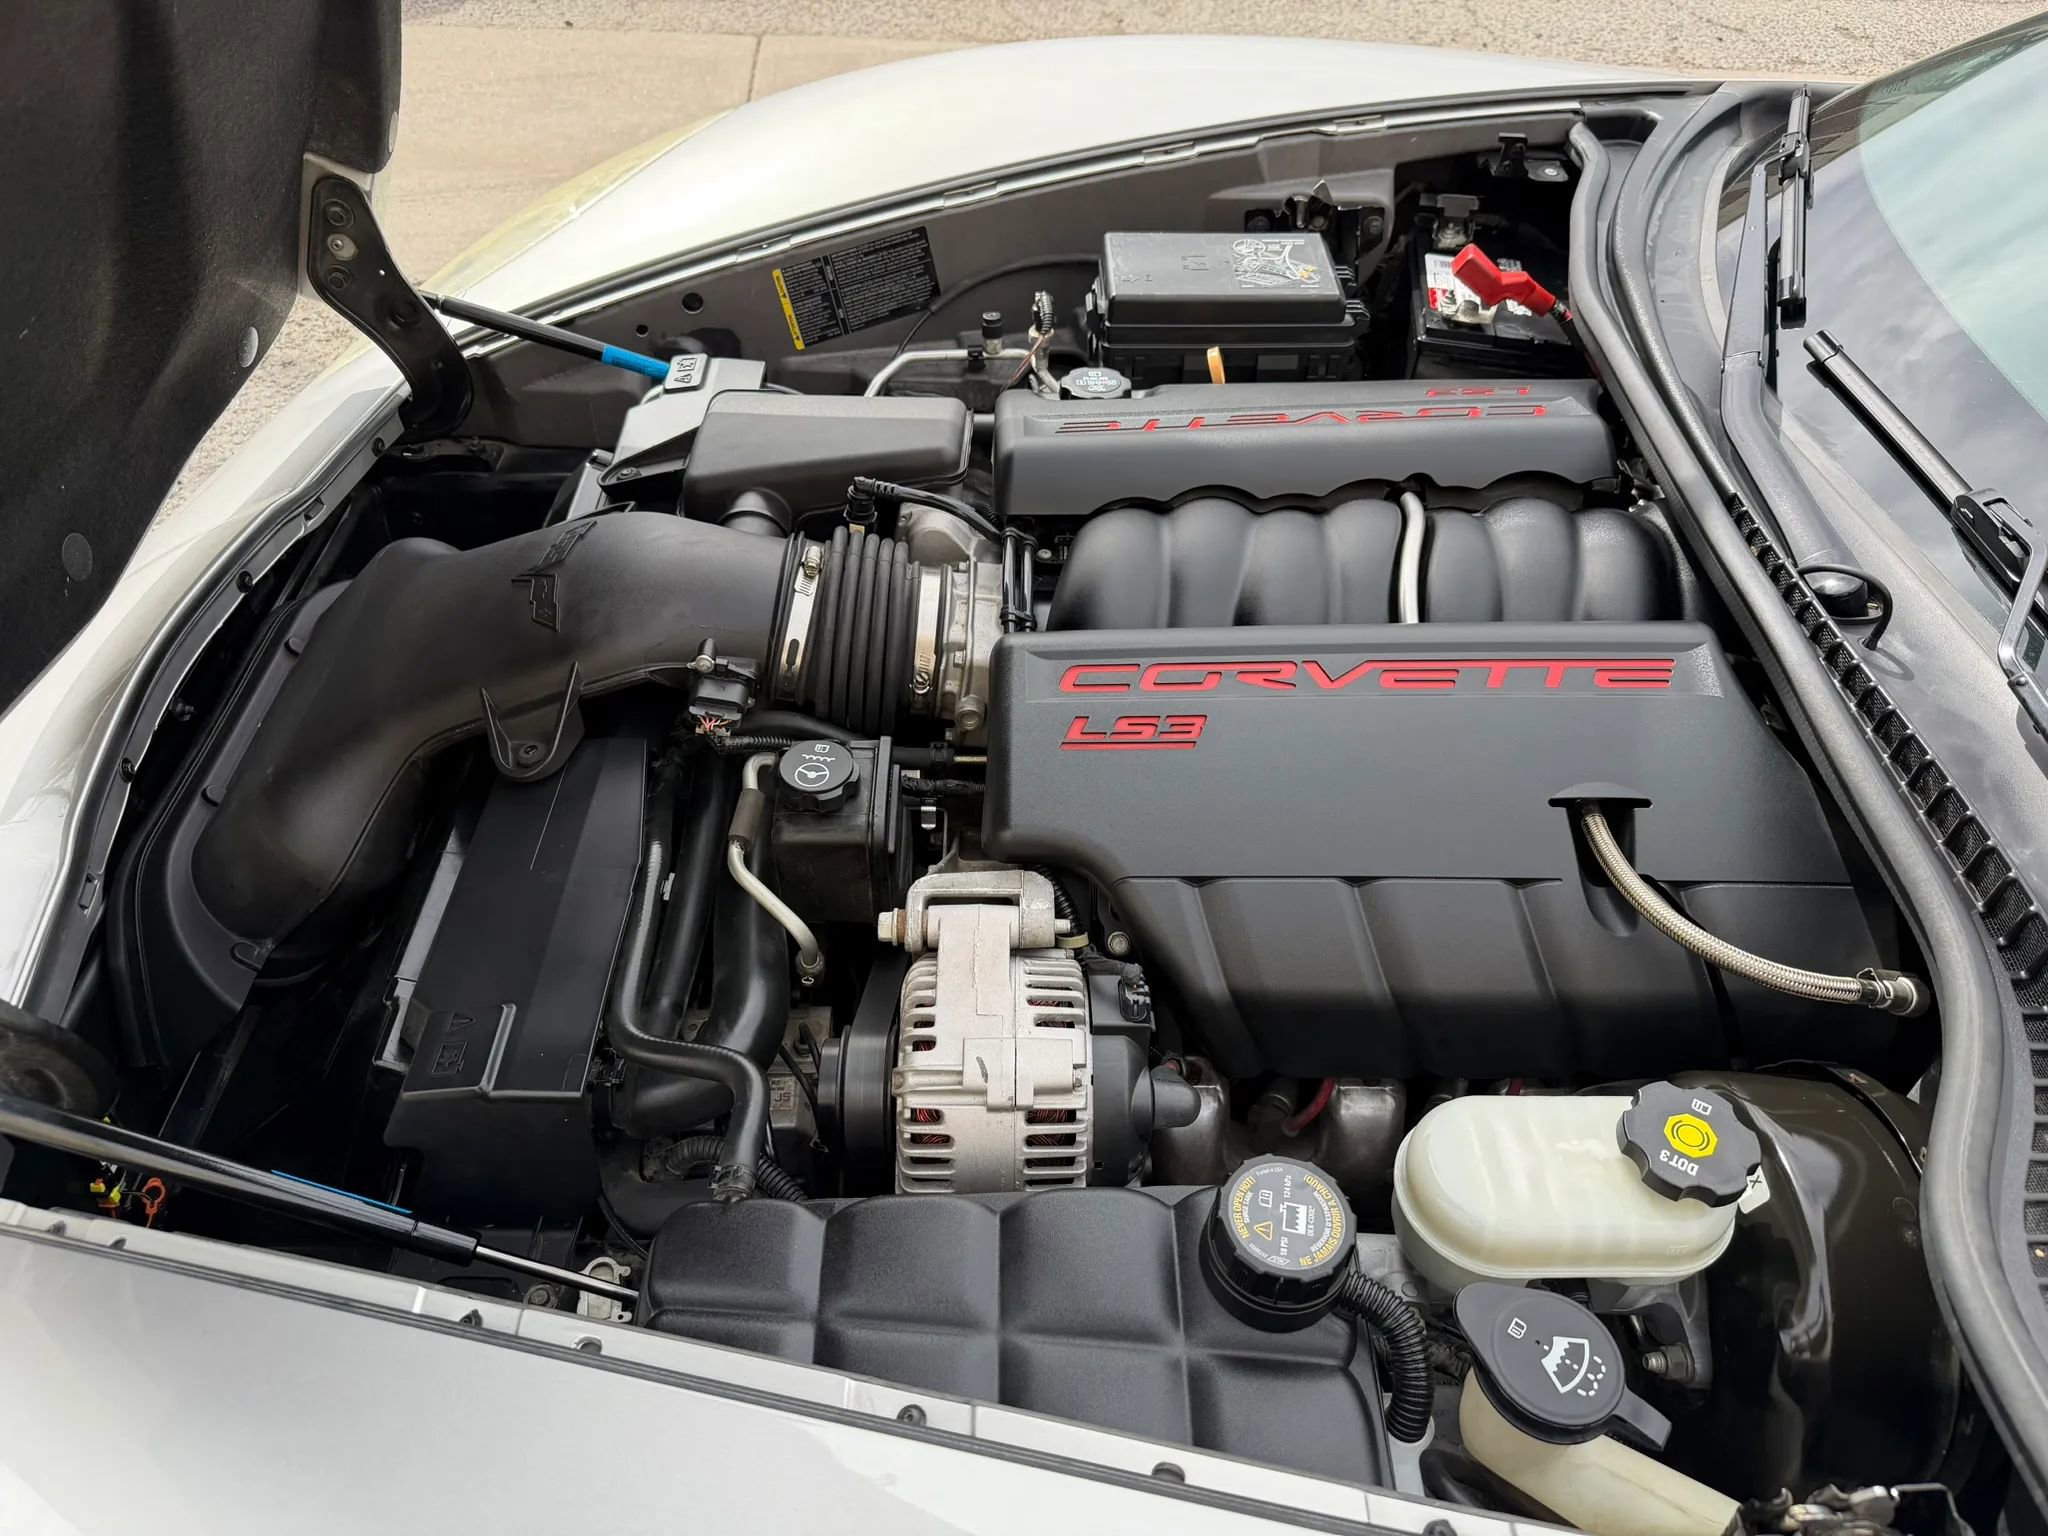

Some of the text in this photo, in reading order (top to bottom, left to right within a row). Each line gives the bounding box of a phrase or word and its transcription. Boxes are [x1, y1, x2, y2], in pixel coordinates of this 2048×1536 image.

[1055, 405, 1547, 433] CORVETTE
[1057, 659, 1677, 693] CORVETTE
[1064, 714, 1208, 741] LS3
[1659, 1149, 1699, 1176] DOT 3
[1303, 1174, 1332, 1200] CHAUD!
[1232, 1175, 1256, 1240] NEVER OPEN HOT!
[1331, 1207, 1342, 1238] OUVRIR
[1299, 1255, 1313, 1266] NE
[1313, 1237, 1338, 1262] JAMAIS
